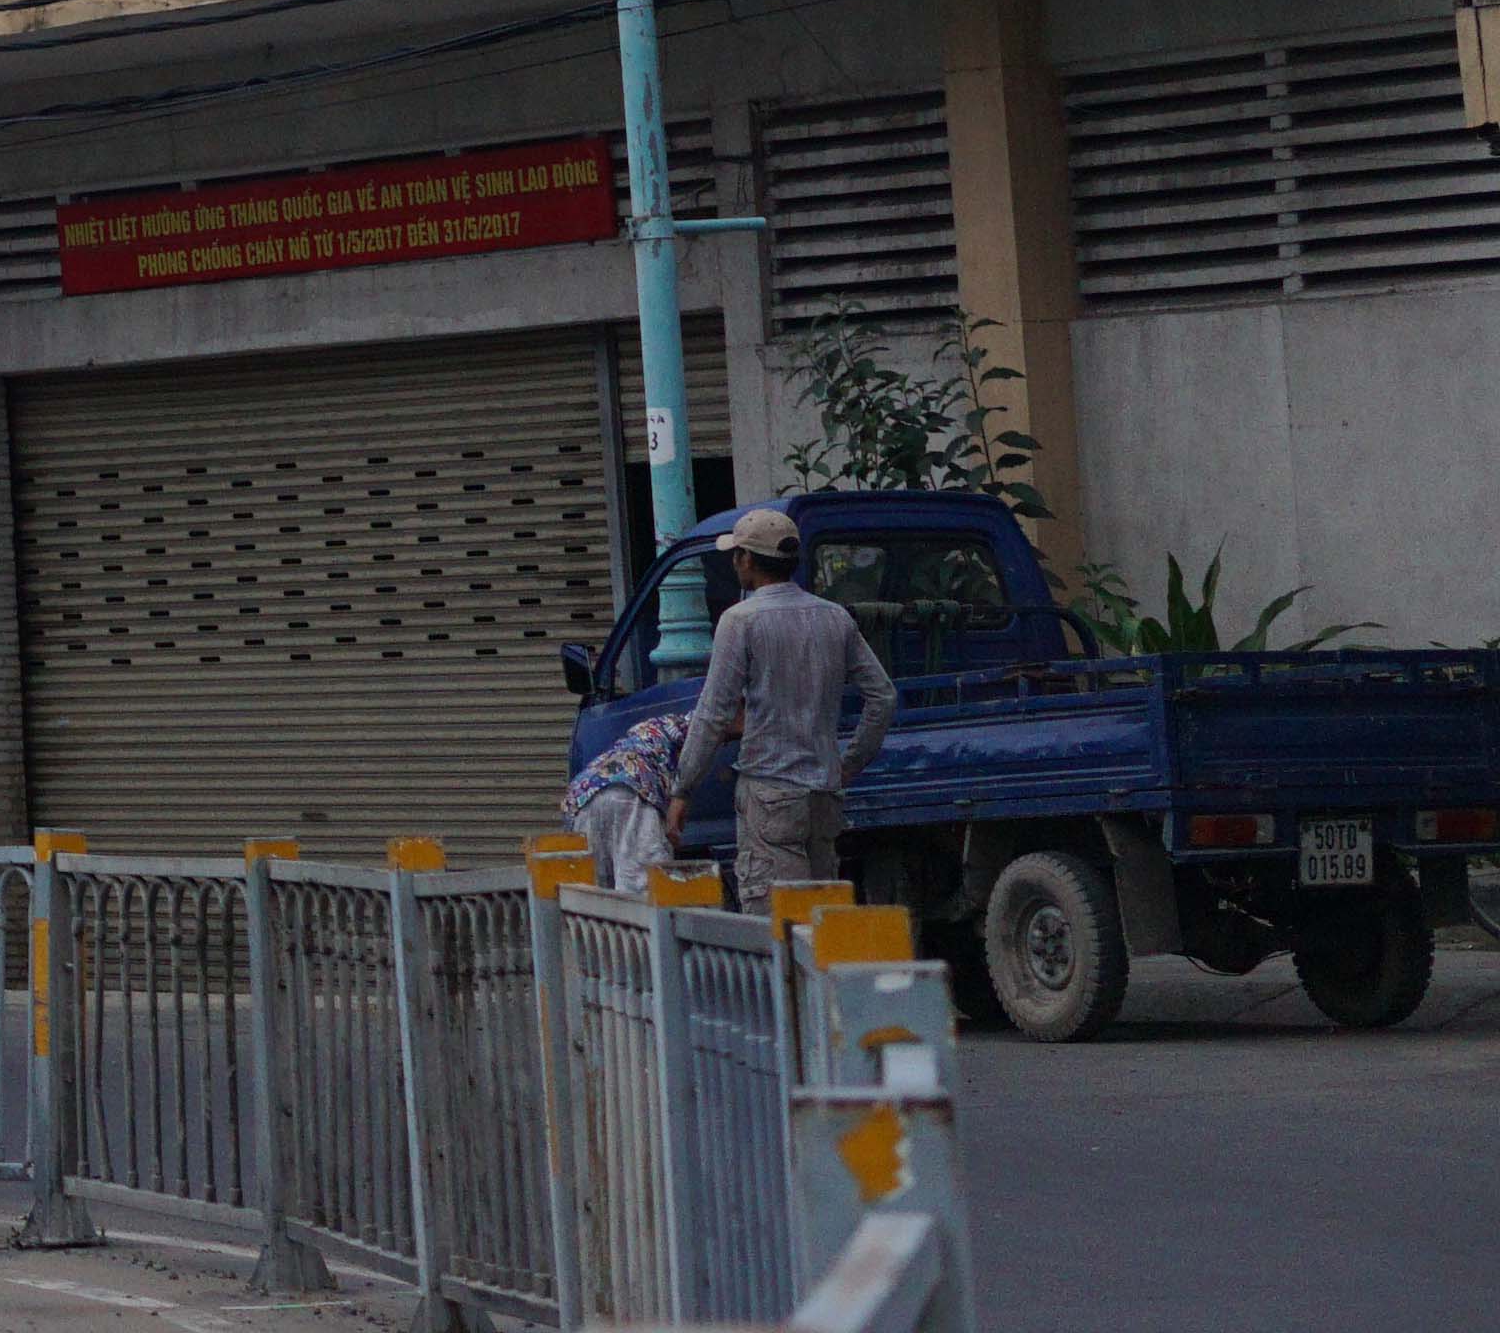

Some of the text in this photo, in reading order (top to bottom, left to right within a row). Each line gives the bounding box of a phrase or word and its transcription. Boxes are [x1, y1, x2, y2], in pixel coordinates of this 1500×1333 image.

[327, 189, 353, 215] GIA
[381, 183, 402, 208] AN
[406, 174, 448, 205] TOÀN
[475, 170, 515, 198] SINH
[518, 165, 547, 192] LAO
[552, 156, 599, 192] ĐỘNG
